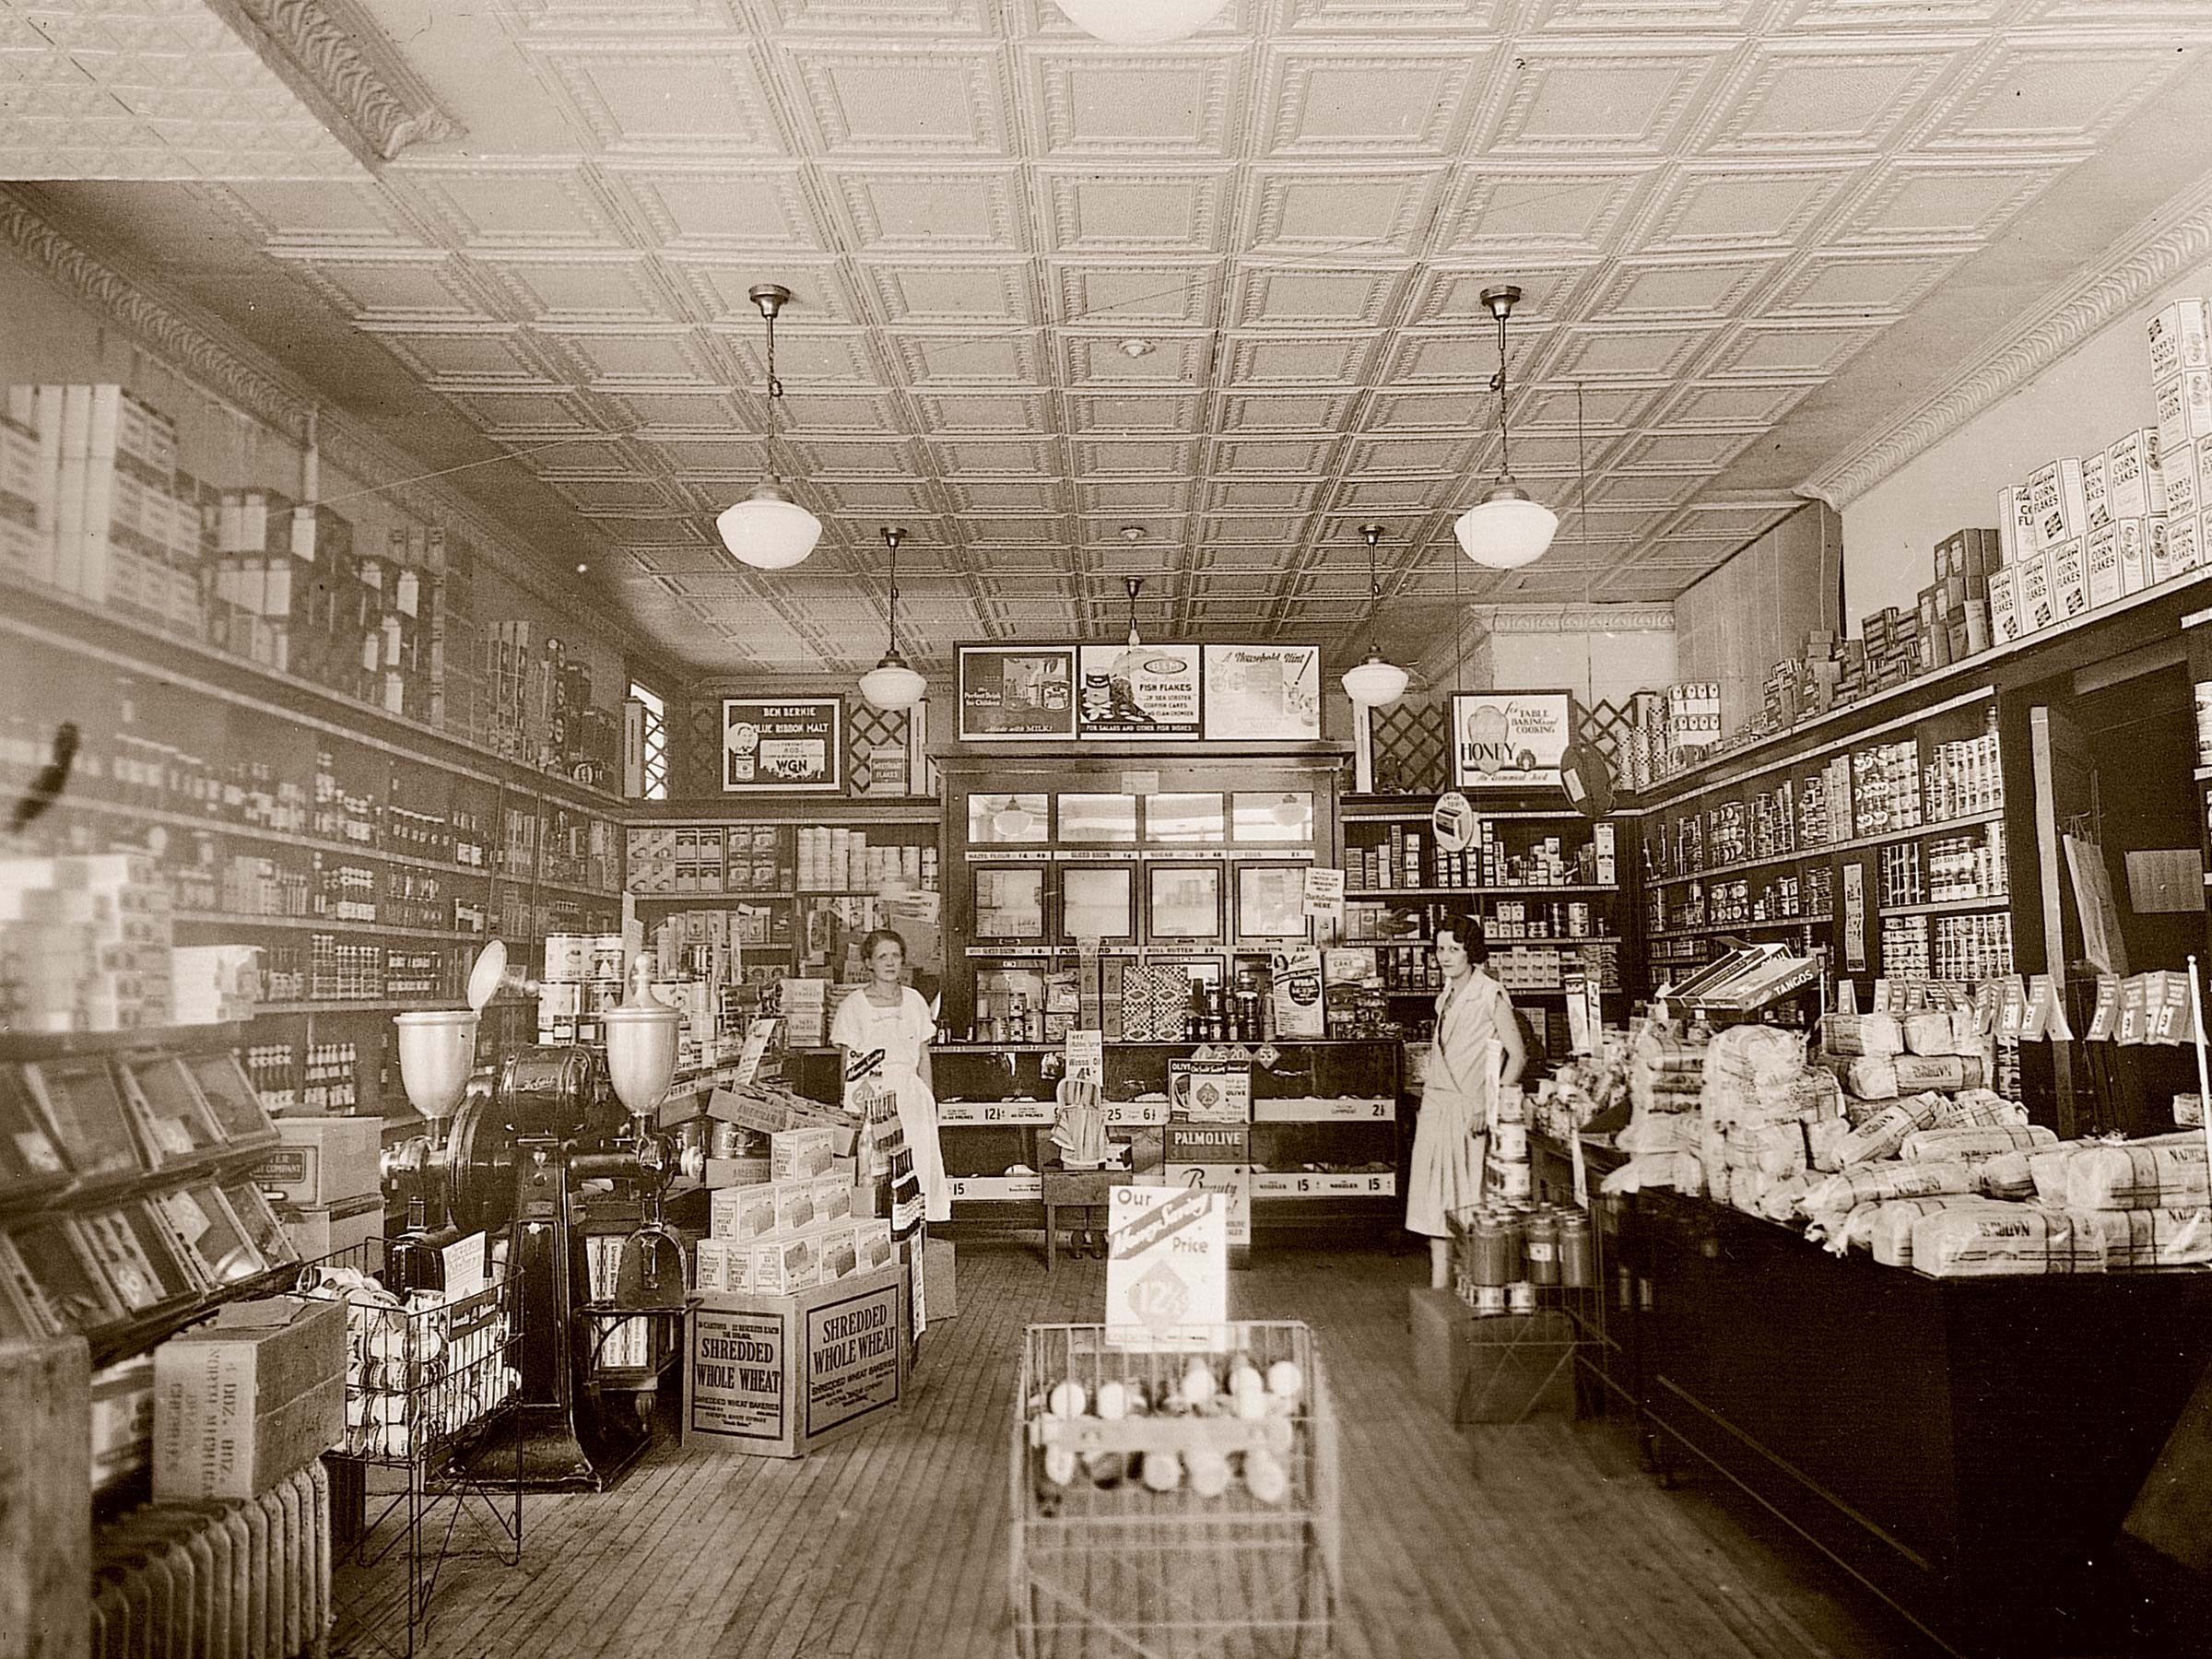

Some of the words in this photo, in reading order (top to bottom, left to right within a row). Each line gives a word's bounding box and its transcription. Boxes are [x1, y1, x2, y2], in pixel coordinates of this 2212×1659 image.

[2113, 456, 2136, 475] CORN
[2084, 477, 2102, 491] ORN
[2112, 466, 2139, 488] FLAKES
[2034, 485, 2055, 500] CORN
[2087, 488, 2105, 501] AKES
[2020, 505, 2033, 514] CO
[2033, 495, 2058, 513] FLAKES
[2091, 546, 2112, 561] CORN
[2057, 560, 2078, 576] CORN
[2090, 556, 2115, 575] FLAKES
[2056, 572, 2081, 588] FLAKES
[1221, 652, 1233, 663] A
[1235, 652, 1281, 663] Household
[1284, 653, 1305, 663] Hint
[762, 707, 782, 717] BEN
[783, 707, 817, 717] BERNIE
[1520, 710, 1549, 718] TABLE
[776, 724, 804, 734] RIBBON
[806, 723, 830, 733] MALT
[1512, 718, 1543, 726] BAKING
[1461, 742, 1516, 760] HONEY
[776, 759, 807, 773] WGN
[1773, 969, 1814, 996] TANGOS
[1230, 1050, 1245, 1060] 20
[1260, 1048, 1274, 1061] 53
[1201, 1093, 1216, 1104] 25
[1107, 1109, 1123, 1121] 25
[1174, 1132, 1241, 1146] PALMOLIVE
[953, 1182, 965, 1195] 15
[1298, 1179, 1309, 1192] 15
[1369, 1178, 1381, 1191] 15
[1117, 1189, 1152, 1206] Our
[1172, 1236, 1209, 1254] Price
[823, 1304, 887, 1344] SHREDDED
[701, 1337, 774, 1363] SHREDDED
[813, 1339, 856, 1375] WHOLE
[858, 1326, 895, 1360] WHEAT
[206, 1348, 221, 1403] NORTH
[696, 1364, 735, 1389] WHOLE
[738, 1368, 781, 1394] WHEAT
[812, 1377, 846, 1395] SHREDDED
[847, 1369, 868, 1382] WHEAT
[868, 1358, 896, 1375] BAKERIES
[221, 1383, 238, 1425] DOZ.
[695, 1395, 726, 1406] SHREDDED
[727, 1399, 748, 1407] WHEAT
[748, 1401, 780, 1410] BAKERIES
